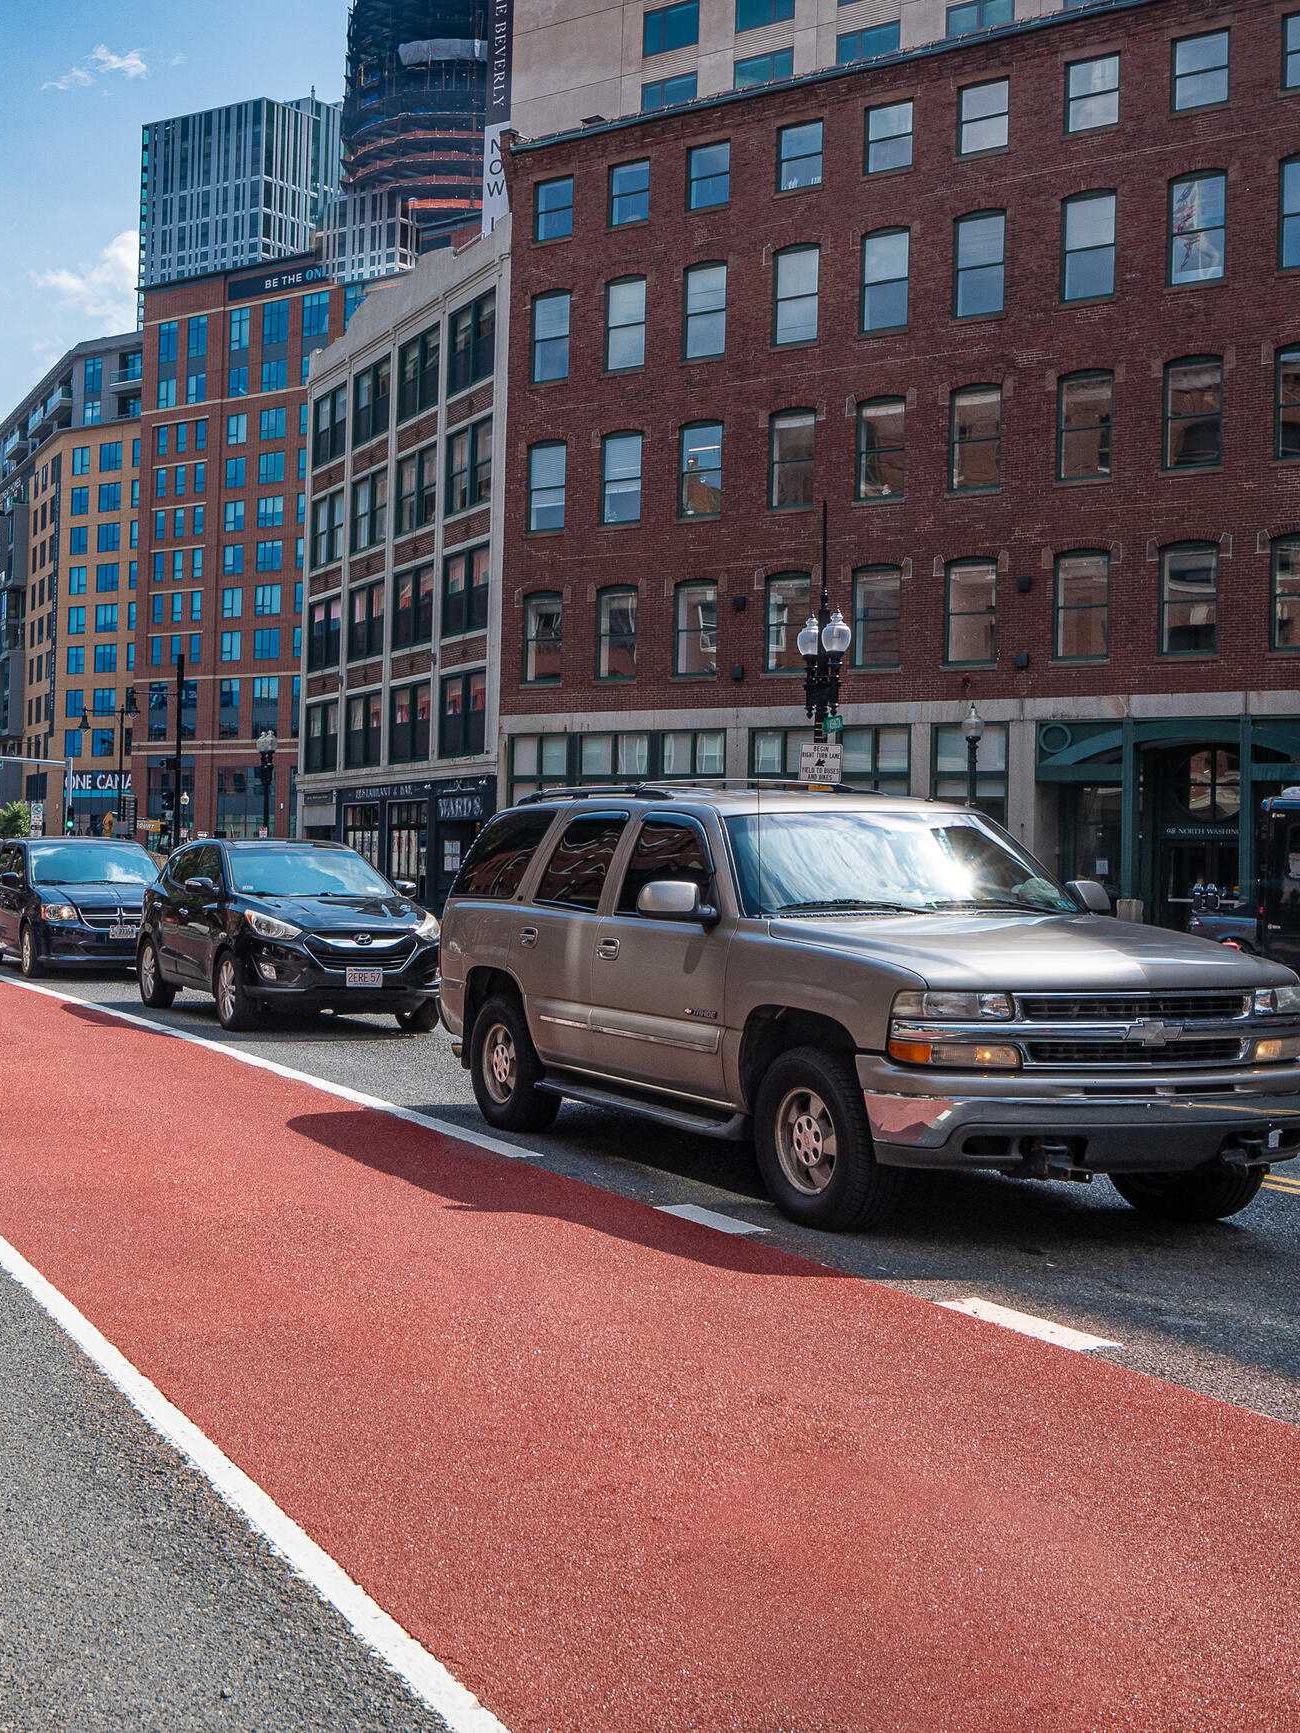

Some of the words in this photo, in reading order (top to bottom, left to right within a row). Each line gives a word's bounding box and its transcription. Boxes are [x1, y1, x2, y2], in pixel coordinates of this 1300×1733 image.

[493, 22, 507, 107] BEVERLY
[264, 277, 279, 289] BE
[281, 272, 303, 285] THE
[813, 745, 829, 753] BEGIN
[829, 752, 841, 760] LANE
[64, 774, 92, 790] ONE
[348, 972, 369, 983] 2ERE
[370, 972, 381, 983] 57
